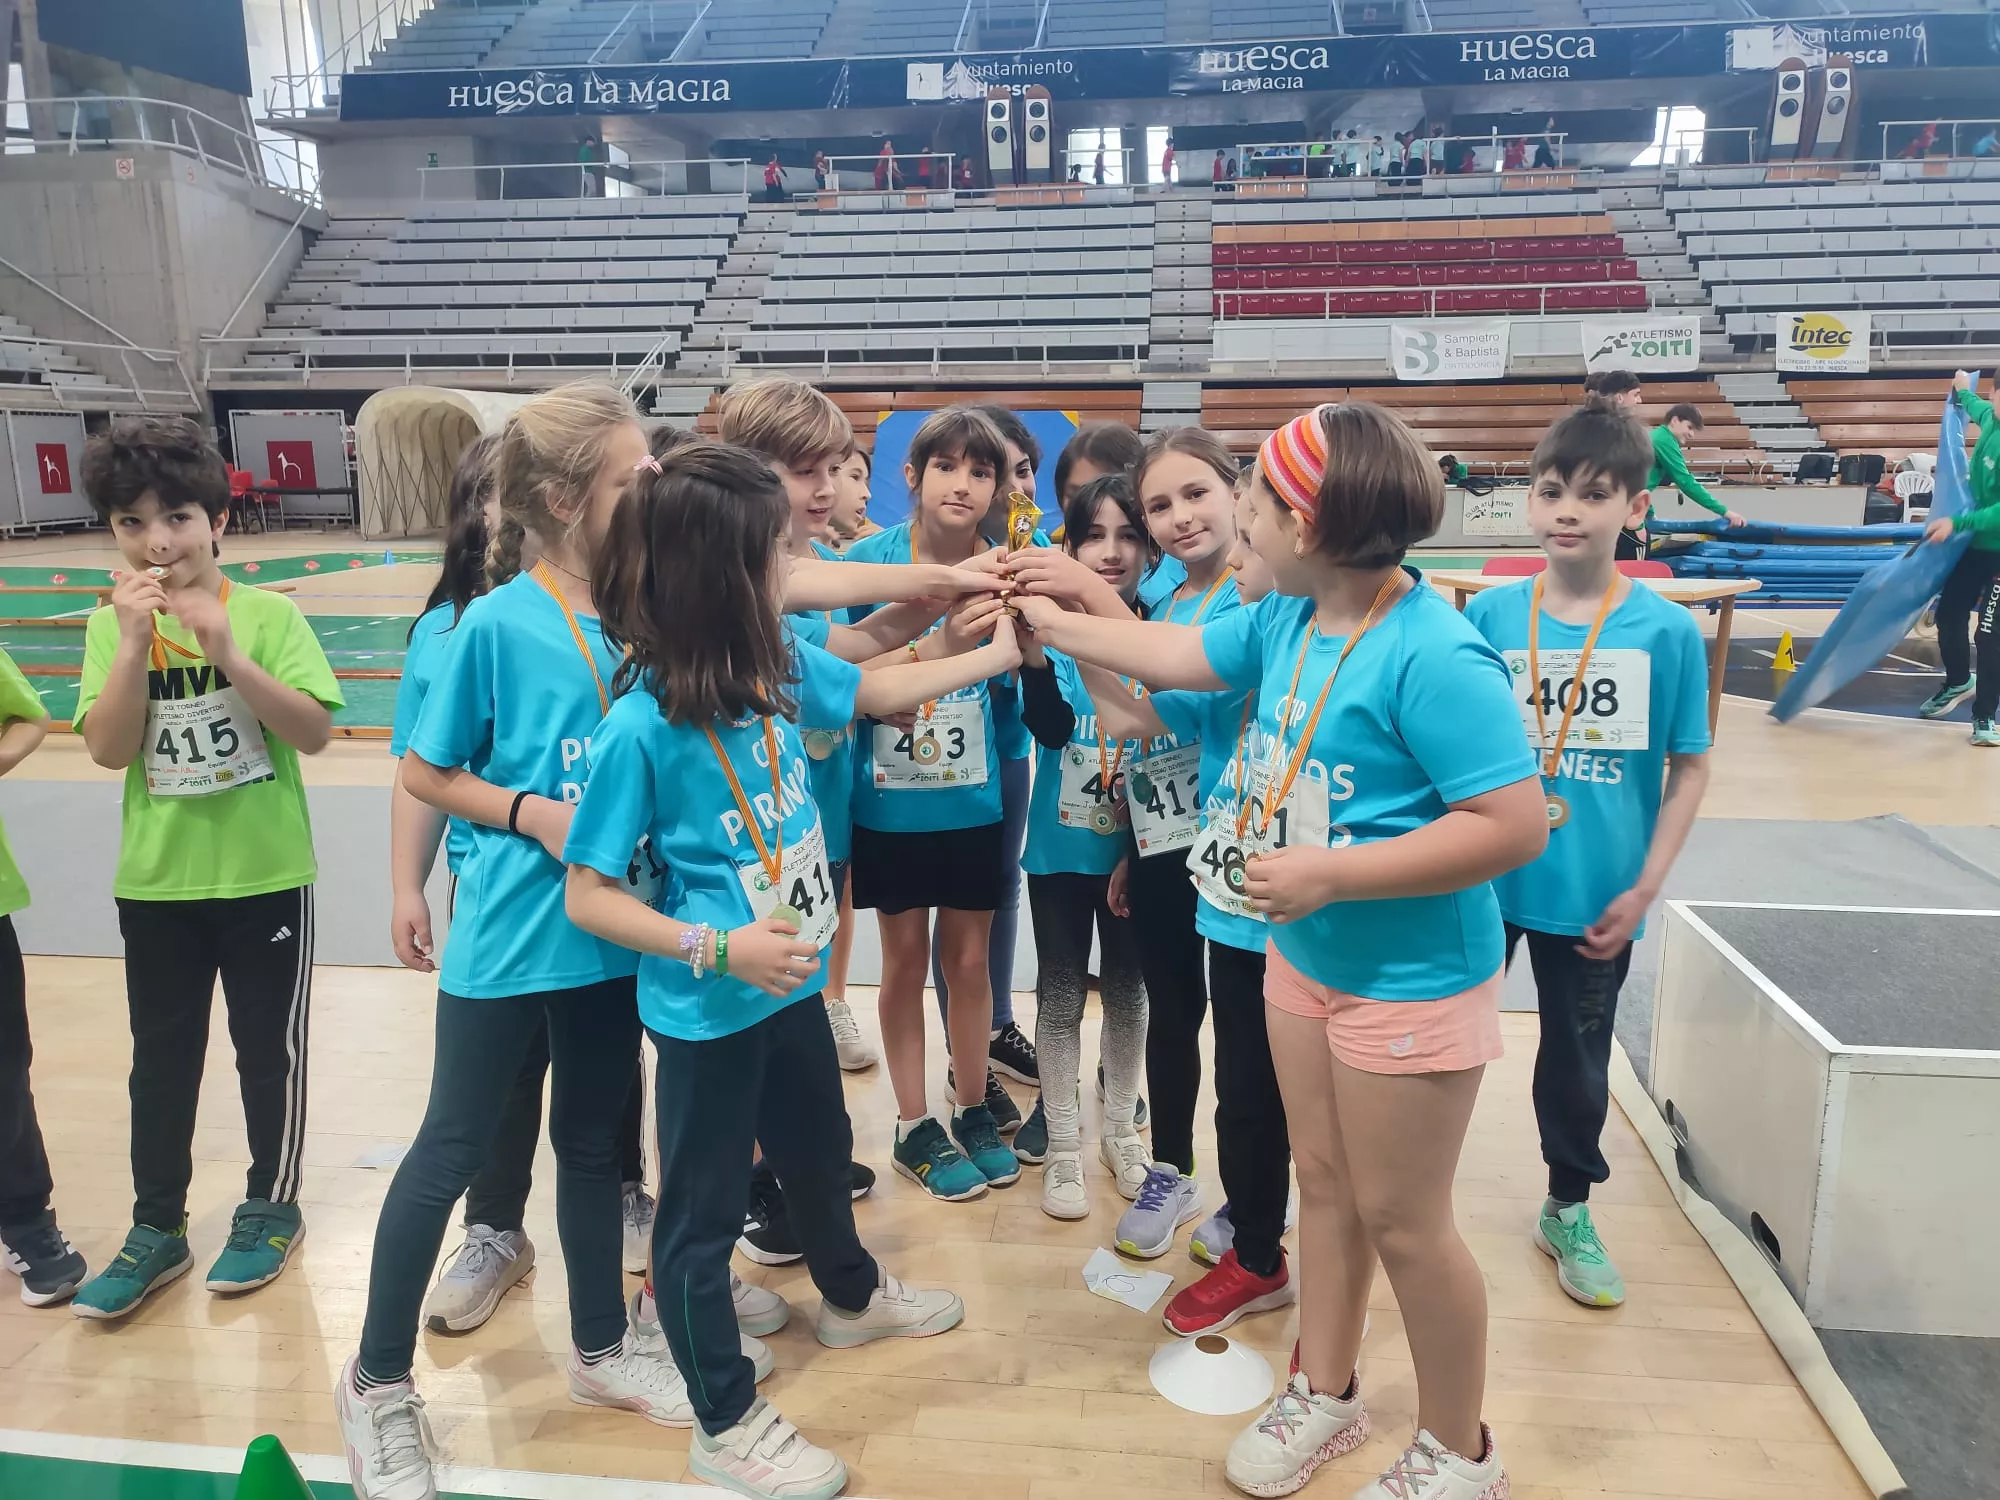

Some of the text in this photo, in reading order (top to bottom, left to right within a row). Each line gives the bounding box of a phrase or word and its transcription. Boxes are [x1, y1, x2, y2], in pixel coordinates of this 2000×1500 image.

[1460, 33, 1597, 62] Huesca
[1198, 45, 1330, 73] Huesca
[448, 79, 575, 108] Huesca
[1444, 334, 1500, 346] Sampietro
[1630, 328, 1693, 339] ATLETISMO
[1791, 316, 1853, 345] intec
[1444, 347, 1500, 359] & Baptista
[1630, 338, 1692, 357] ZOITI
[1785, 647, 1794, 664] 1
[176, 700, 206, 711] TORNEO
[1526, 677, 1619, 717] 408
[187, 703, 225, 718] DIVERTIDO
[155, 717, 240, 765] 415
